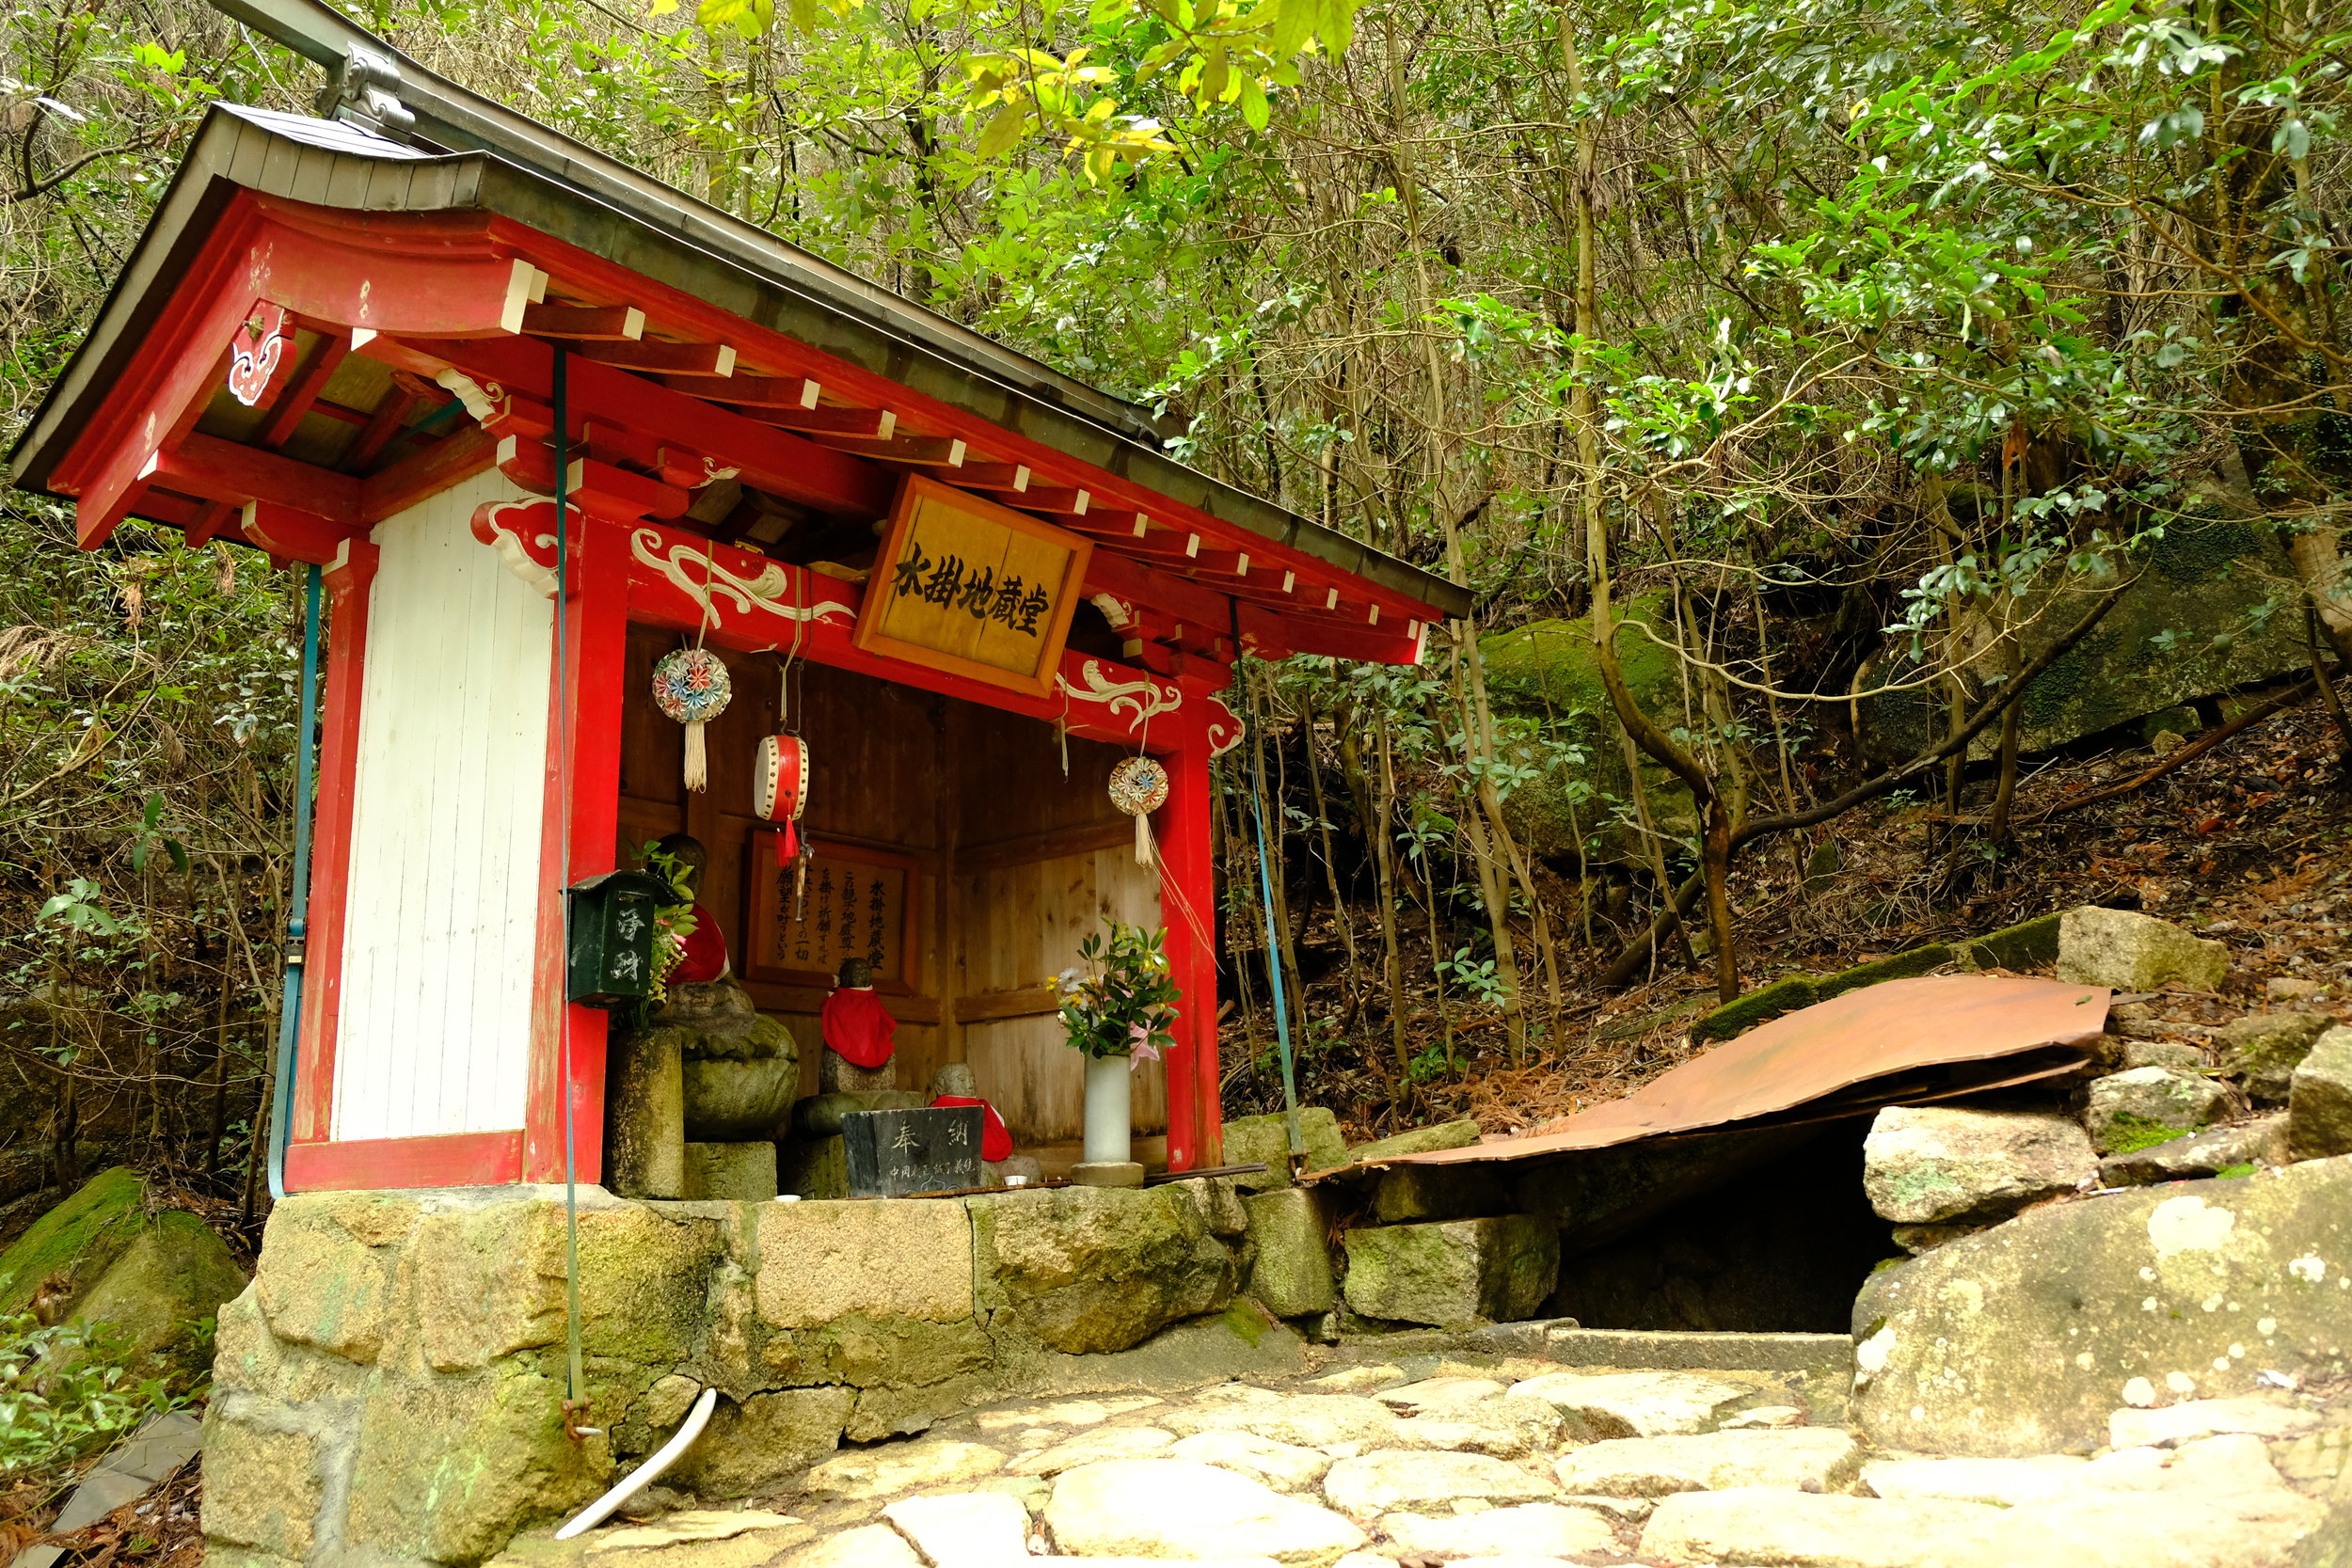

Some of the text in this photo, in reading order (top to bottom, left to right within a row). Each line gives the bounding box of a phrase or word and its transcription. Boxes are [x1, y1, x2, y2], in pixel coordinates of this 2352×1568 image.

[891, 541, 1050, 638] 水掛地蔵堂
[866, 879, 886, 971] 水掛地蔵堂
